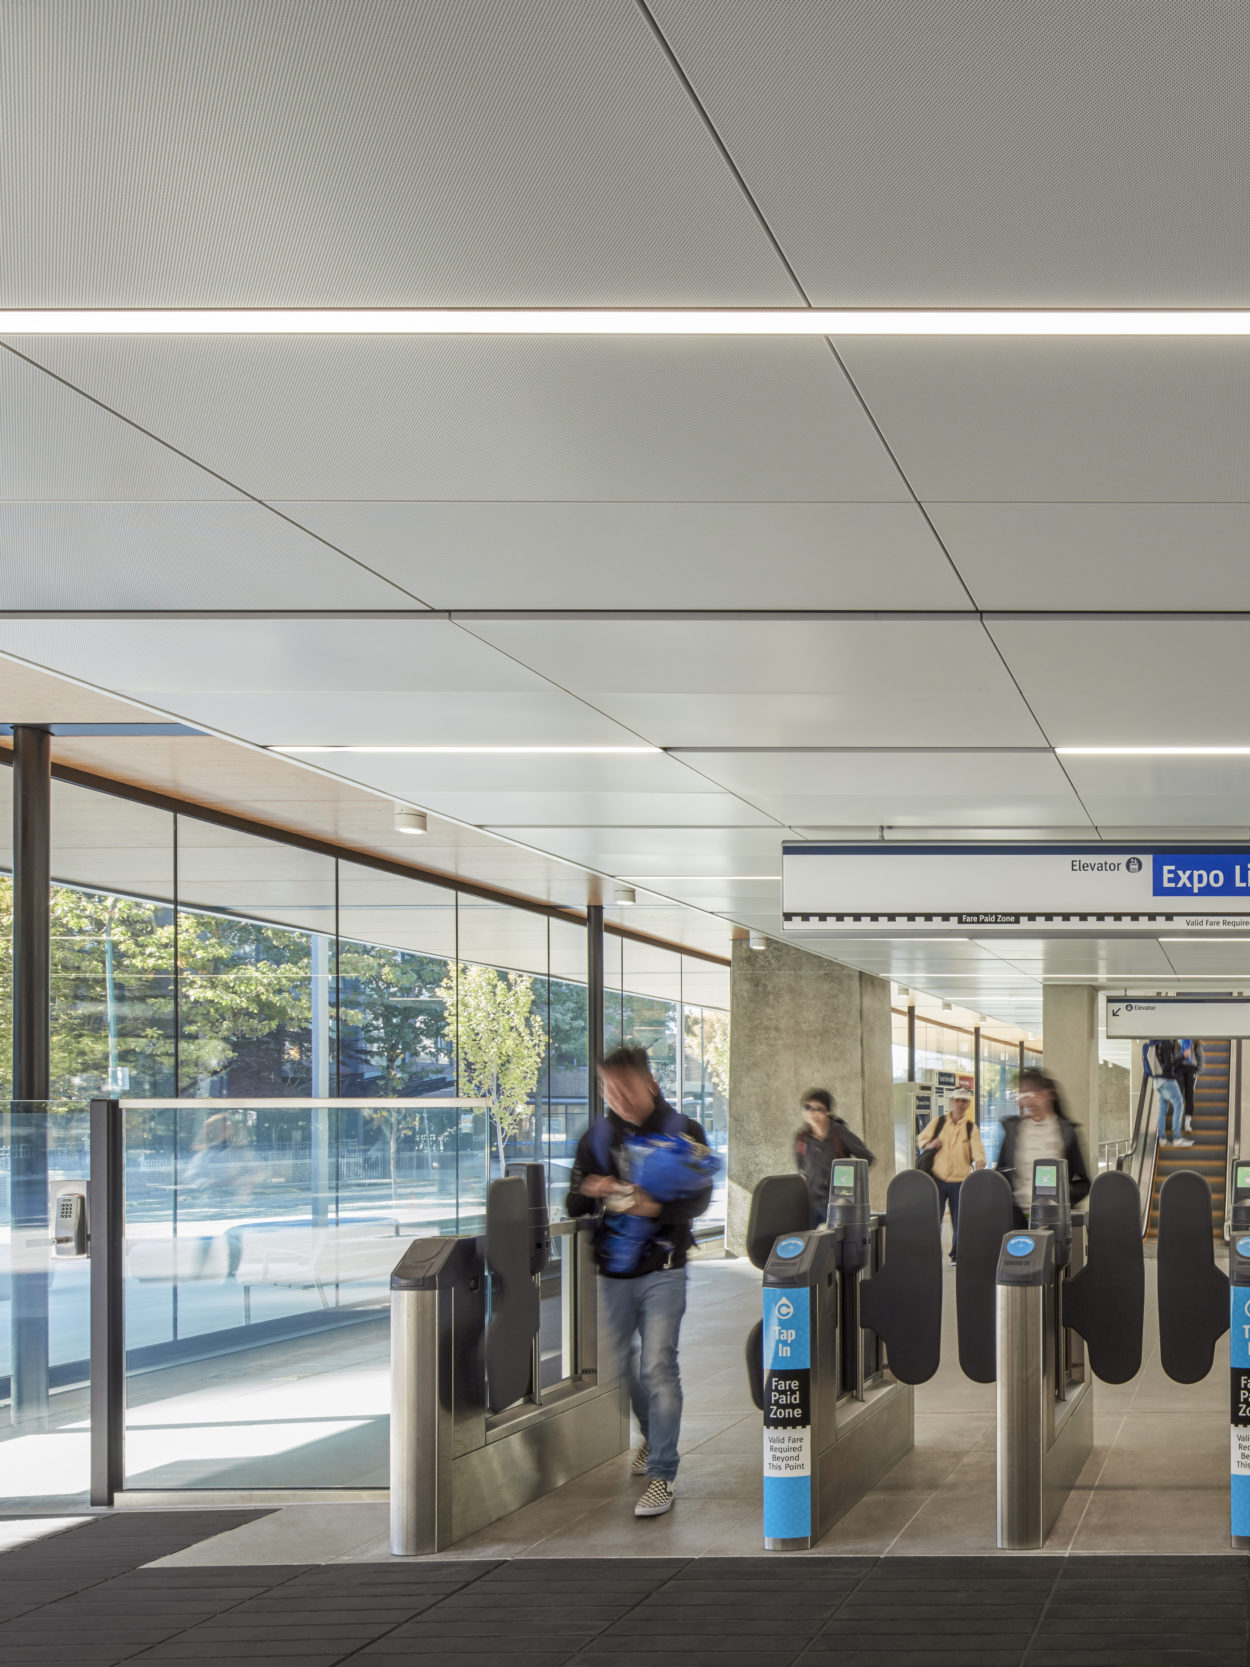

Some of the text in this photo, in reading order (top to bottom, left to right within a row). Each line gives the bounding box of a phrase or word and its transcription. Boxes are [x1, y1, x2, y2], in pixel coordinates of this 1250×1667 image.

[1071, 859, 1122, 872] Elevator
[1162, 865, 1224, 893] Expo
[962, 914, 1015, 922] Fare Paid Zone
[1186, 919, 1203, 927] Valid
[1205, 919, 1221, 927] Fare
[774, 1327, 795, 1343] Tap
[779, 1344, 790, 1357] In
[771, 1378, 799, 1391] Fare
[771, 1392, 799, 1404] Paid
[770, 1406, 802, 1418] Zone
[768, 1436, 785, 1444] Valid
[769, 1445, 802, 1454] Required
[772, 1454, 799, 1463] Beyond
[768, 1462, 782, 1471] This
[1236, 1461, 1250, 1469] This
